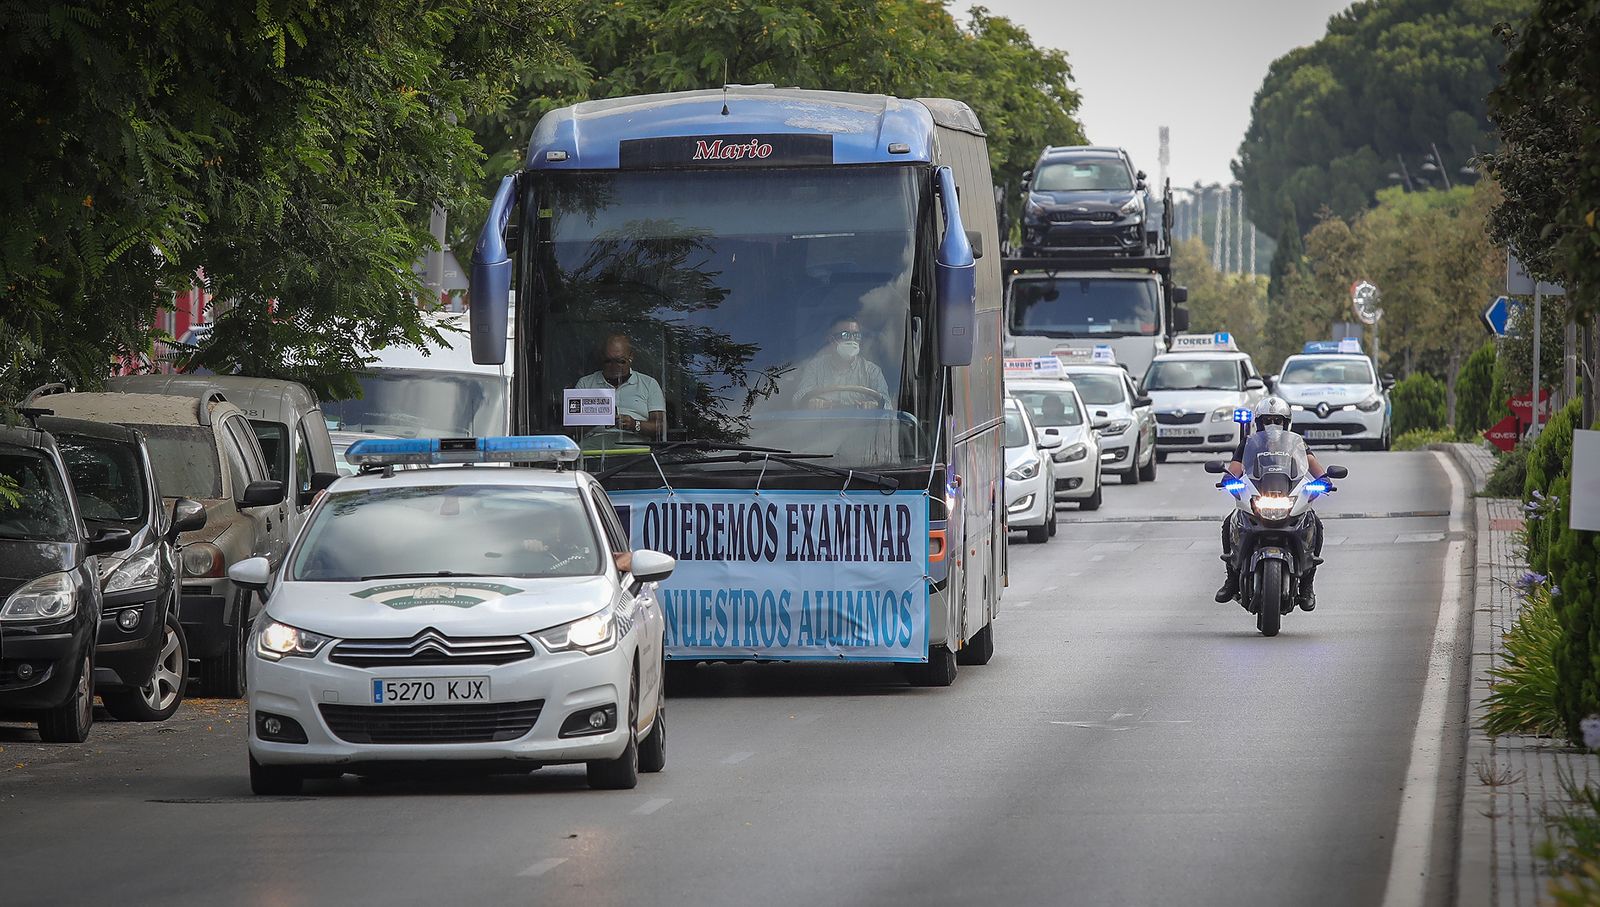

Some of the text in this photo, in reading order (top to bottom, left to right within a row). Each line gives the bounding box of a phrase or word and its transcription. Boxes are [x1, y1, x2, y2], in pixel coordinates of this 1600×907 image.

[693, 138, 773, 160] Mario
[1512, 399, 1533, 408] ROMER
[1491, 432, 1517, 440] ROMERO
[643, 502, 912, 564] QUEREMOS EXAMINAR
[664, 588, 914, 649] NUESTROS ALUMNOS
[387, 681, 484, 701] 5270 KJX
